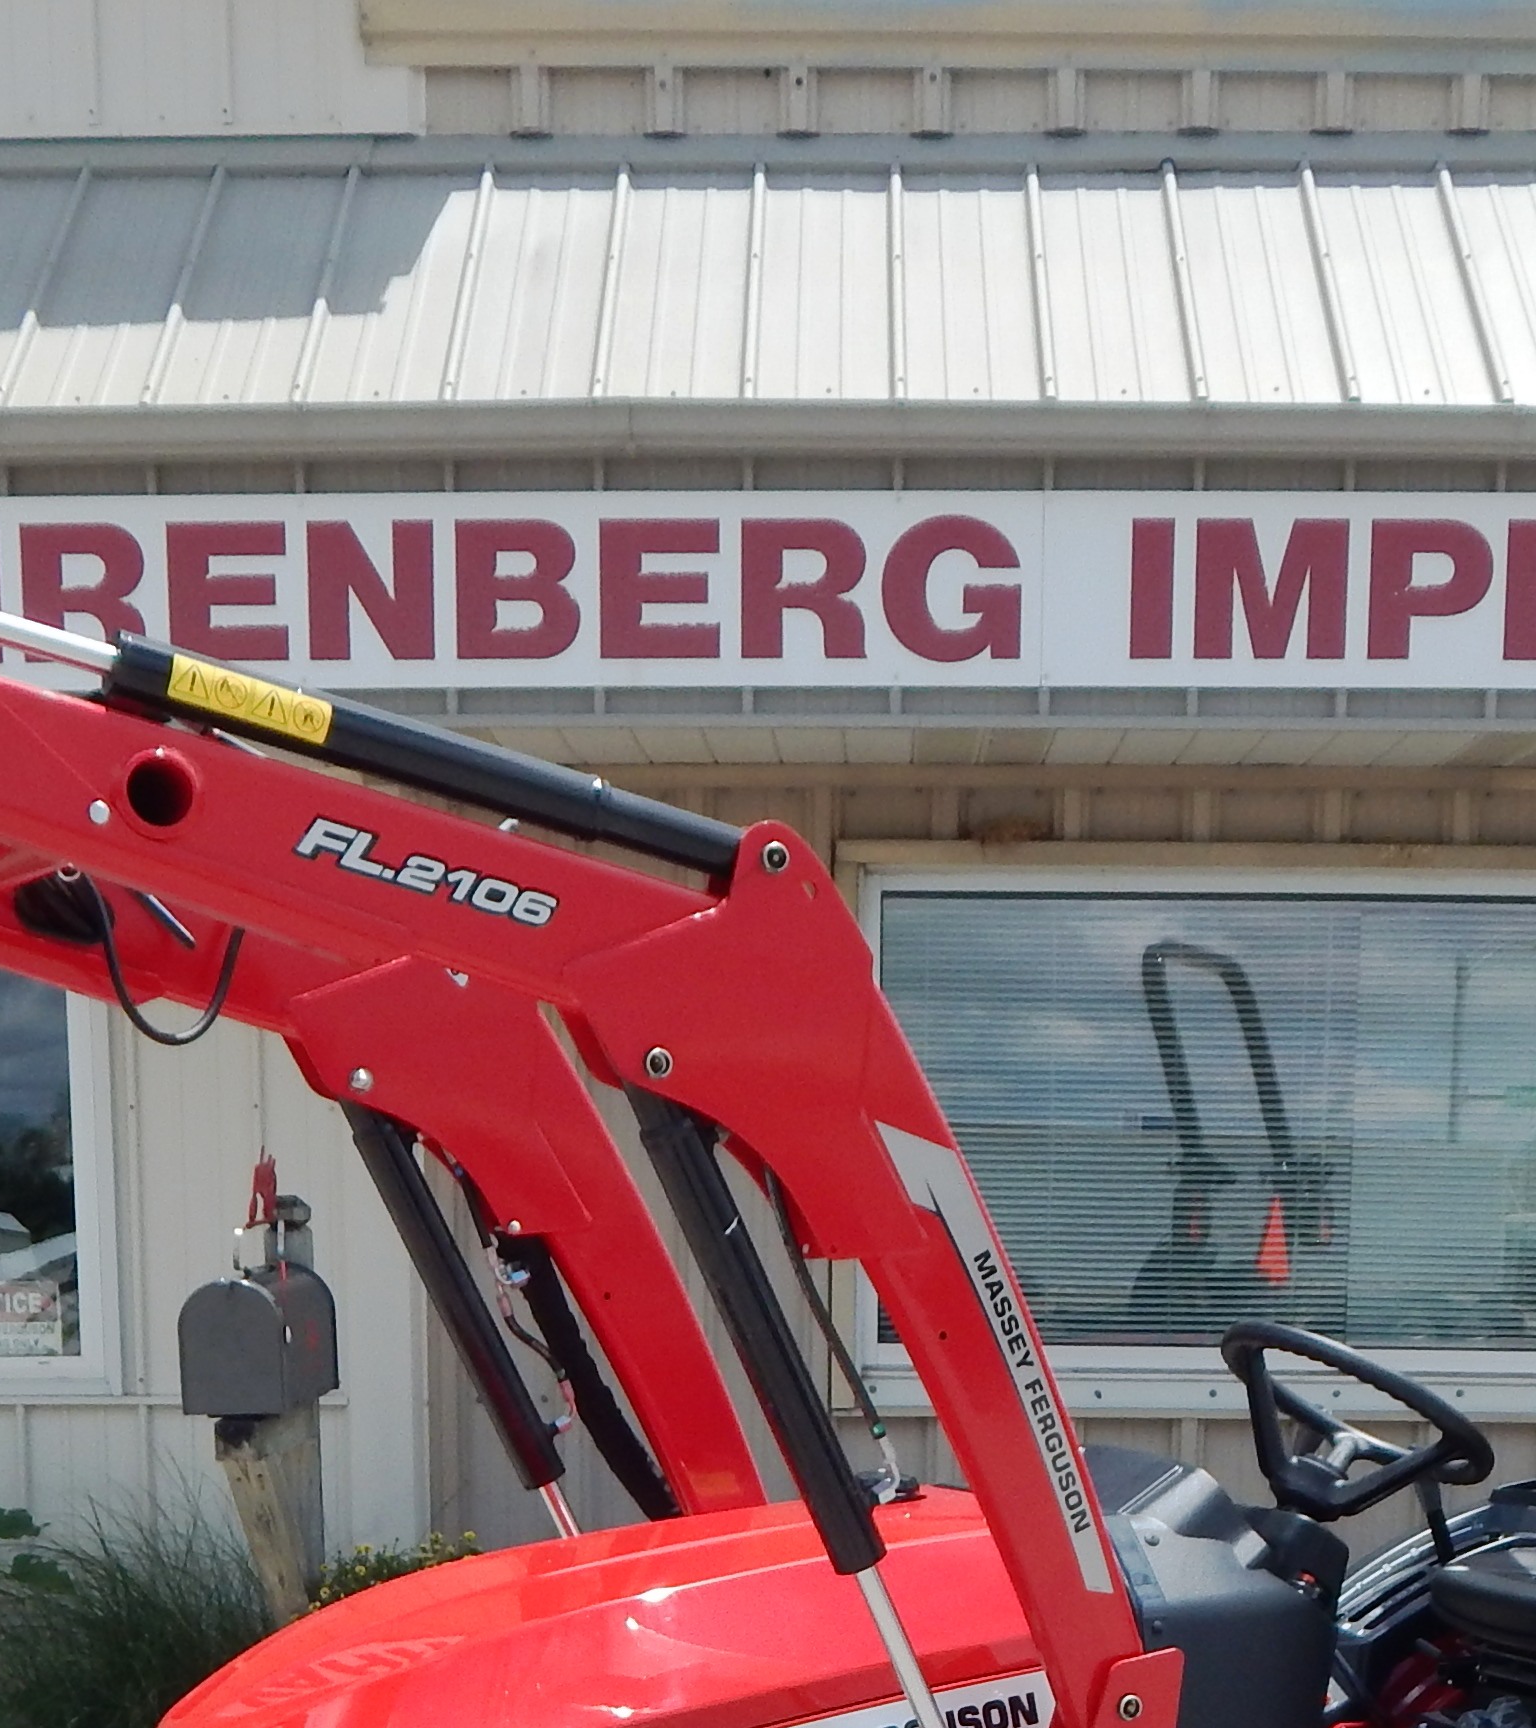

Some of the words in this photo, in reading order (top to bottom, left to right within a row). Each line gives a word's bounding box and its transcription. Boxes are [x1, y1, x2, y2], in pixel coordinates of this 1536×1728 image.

[292, 814, 560, 927] FL.2106
[973, 1248, 1035, 1370] MASSEY
[1024, 1377, 1092, 1534] FERGUSON
